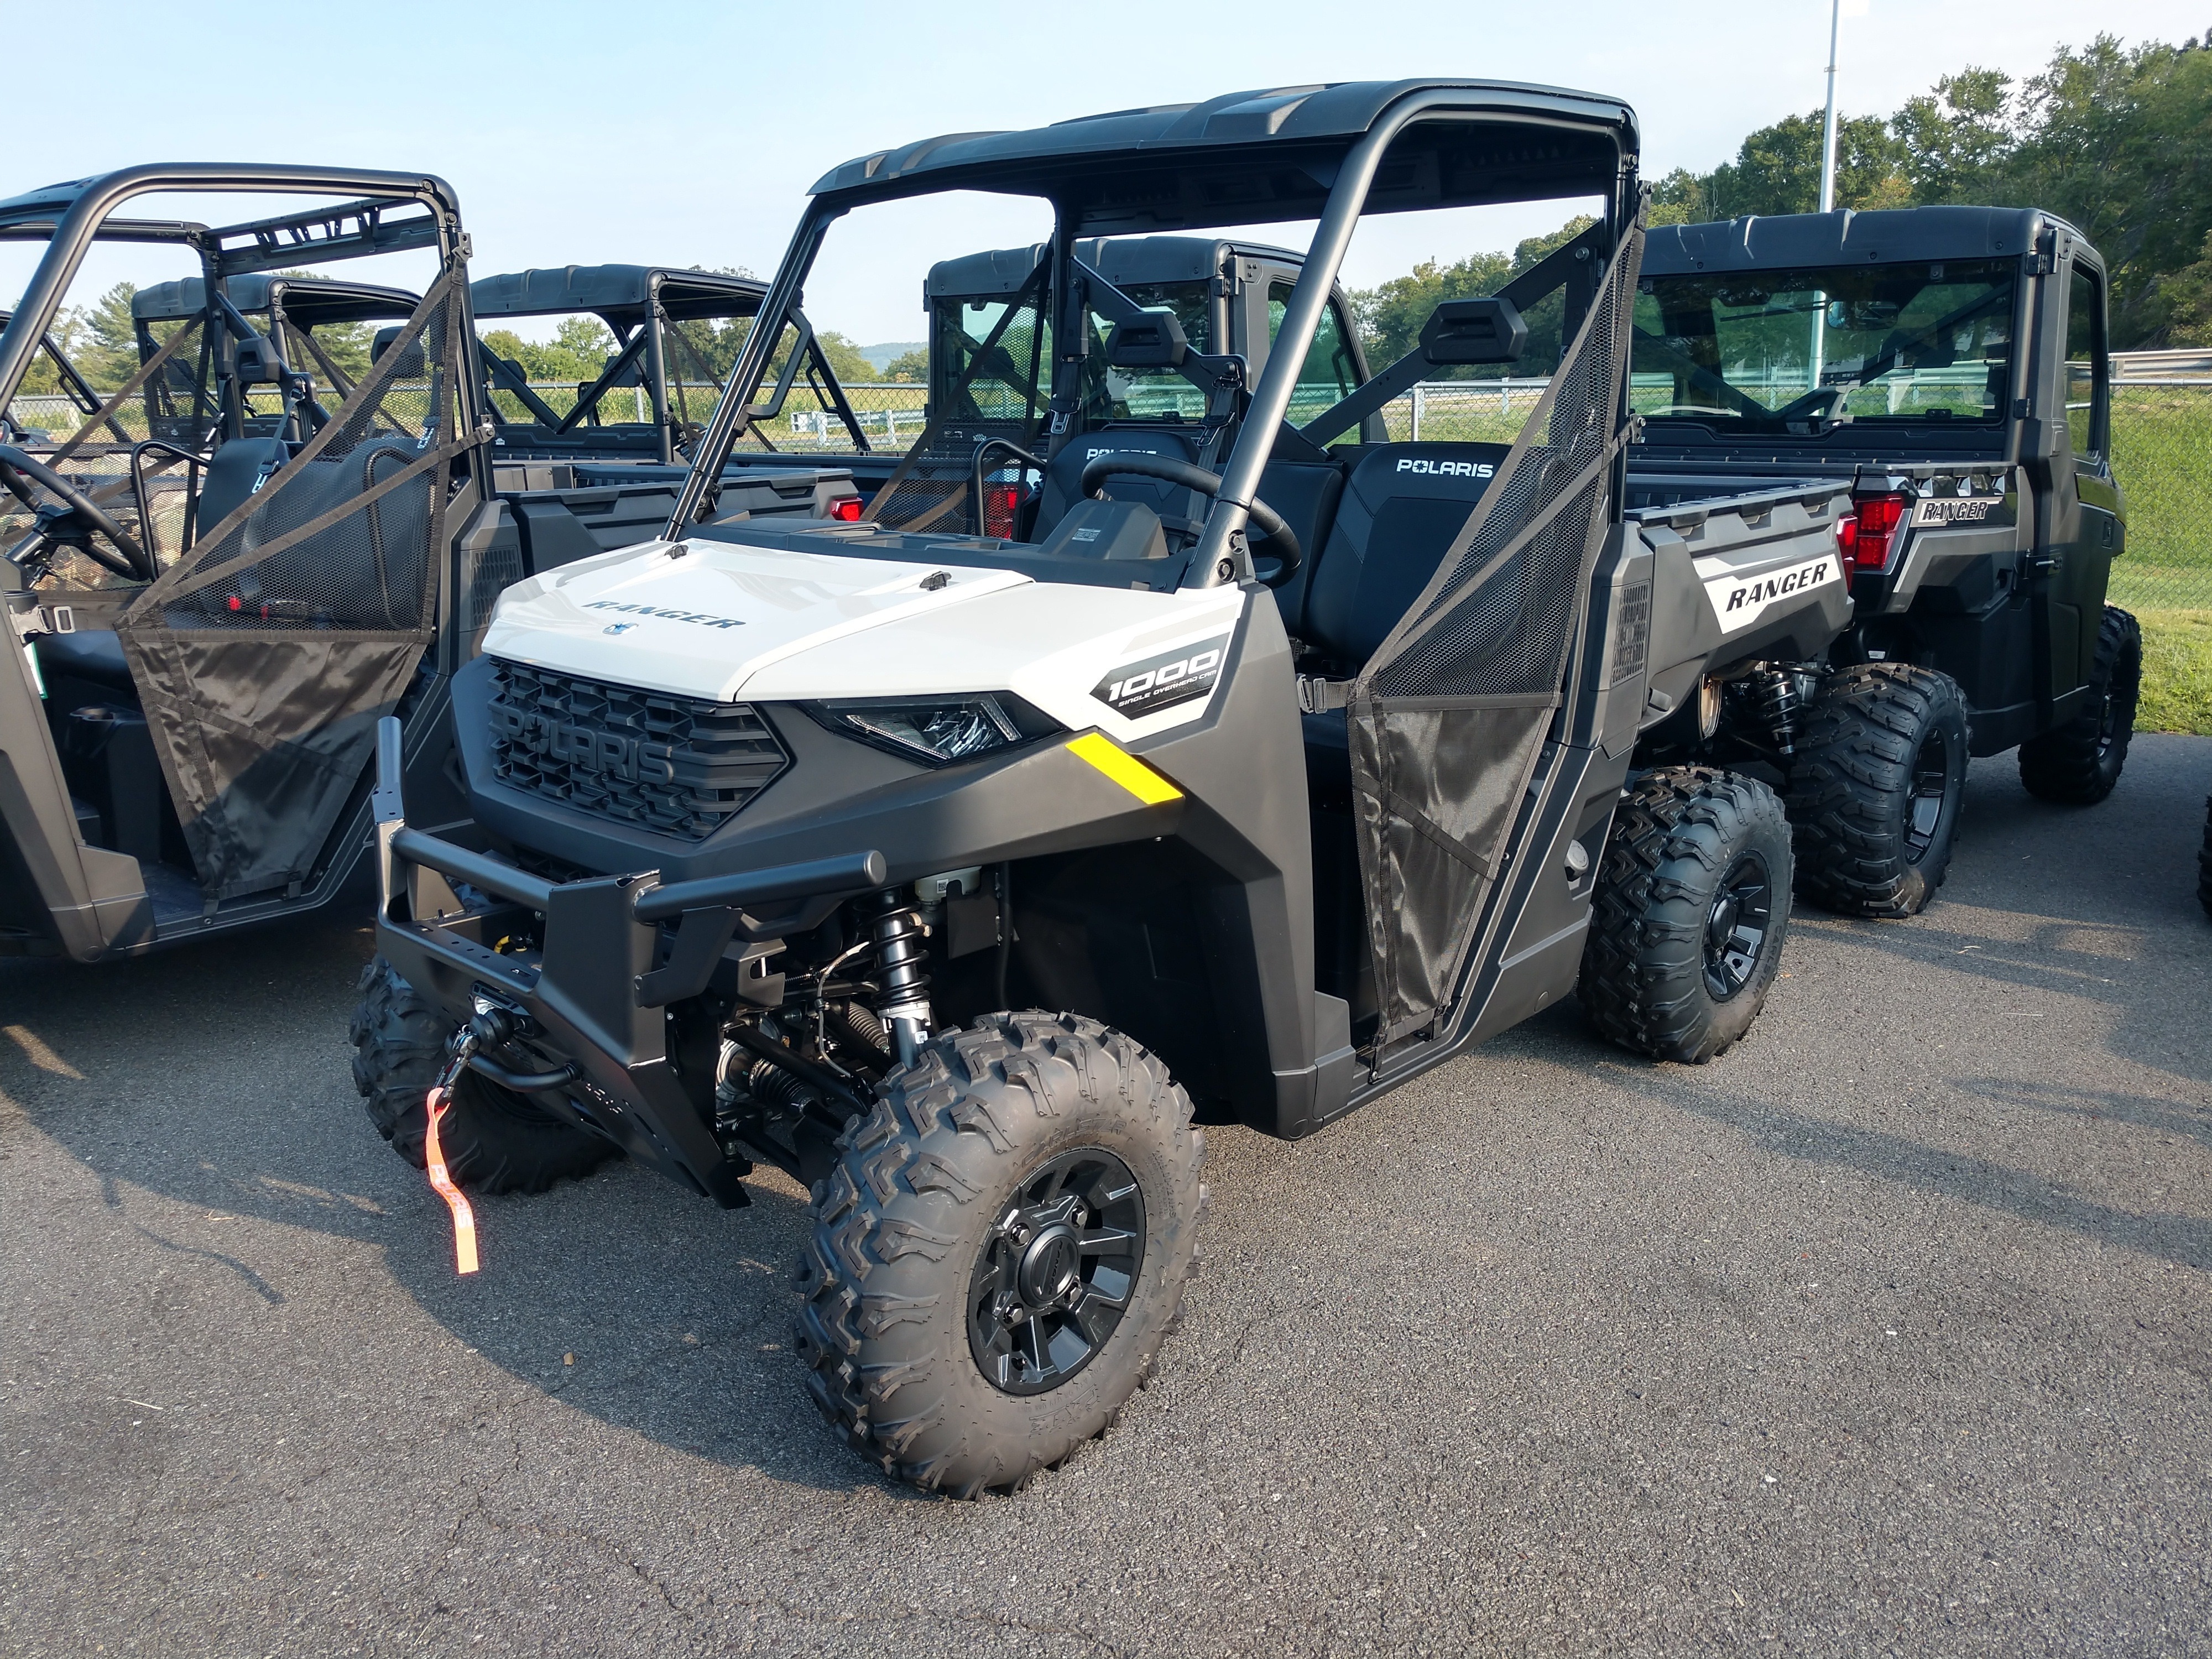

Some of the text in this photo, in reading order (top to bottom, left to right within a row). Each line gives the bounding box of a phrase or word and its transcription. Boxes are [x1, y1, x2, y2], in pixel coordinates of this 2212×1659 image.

[1396, 459, 1493, 478] POLARIS
[1922, 502, 1988, 521] RANGER
[1726, 562, 1828, 612] RANGER
[581, 601, 746, 629] RANGER
[1108, 649, 1220, 702] 1000
[1118, 670, 1217, 707] SINGLE OVERHEAD CAM
[500, 703, 674, 786] POLARIS
[431, 1165, 473, 1228] POLARIS
